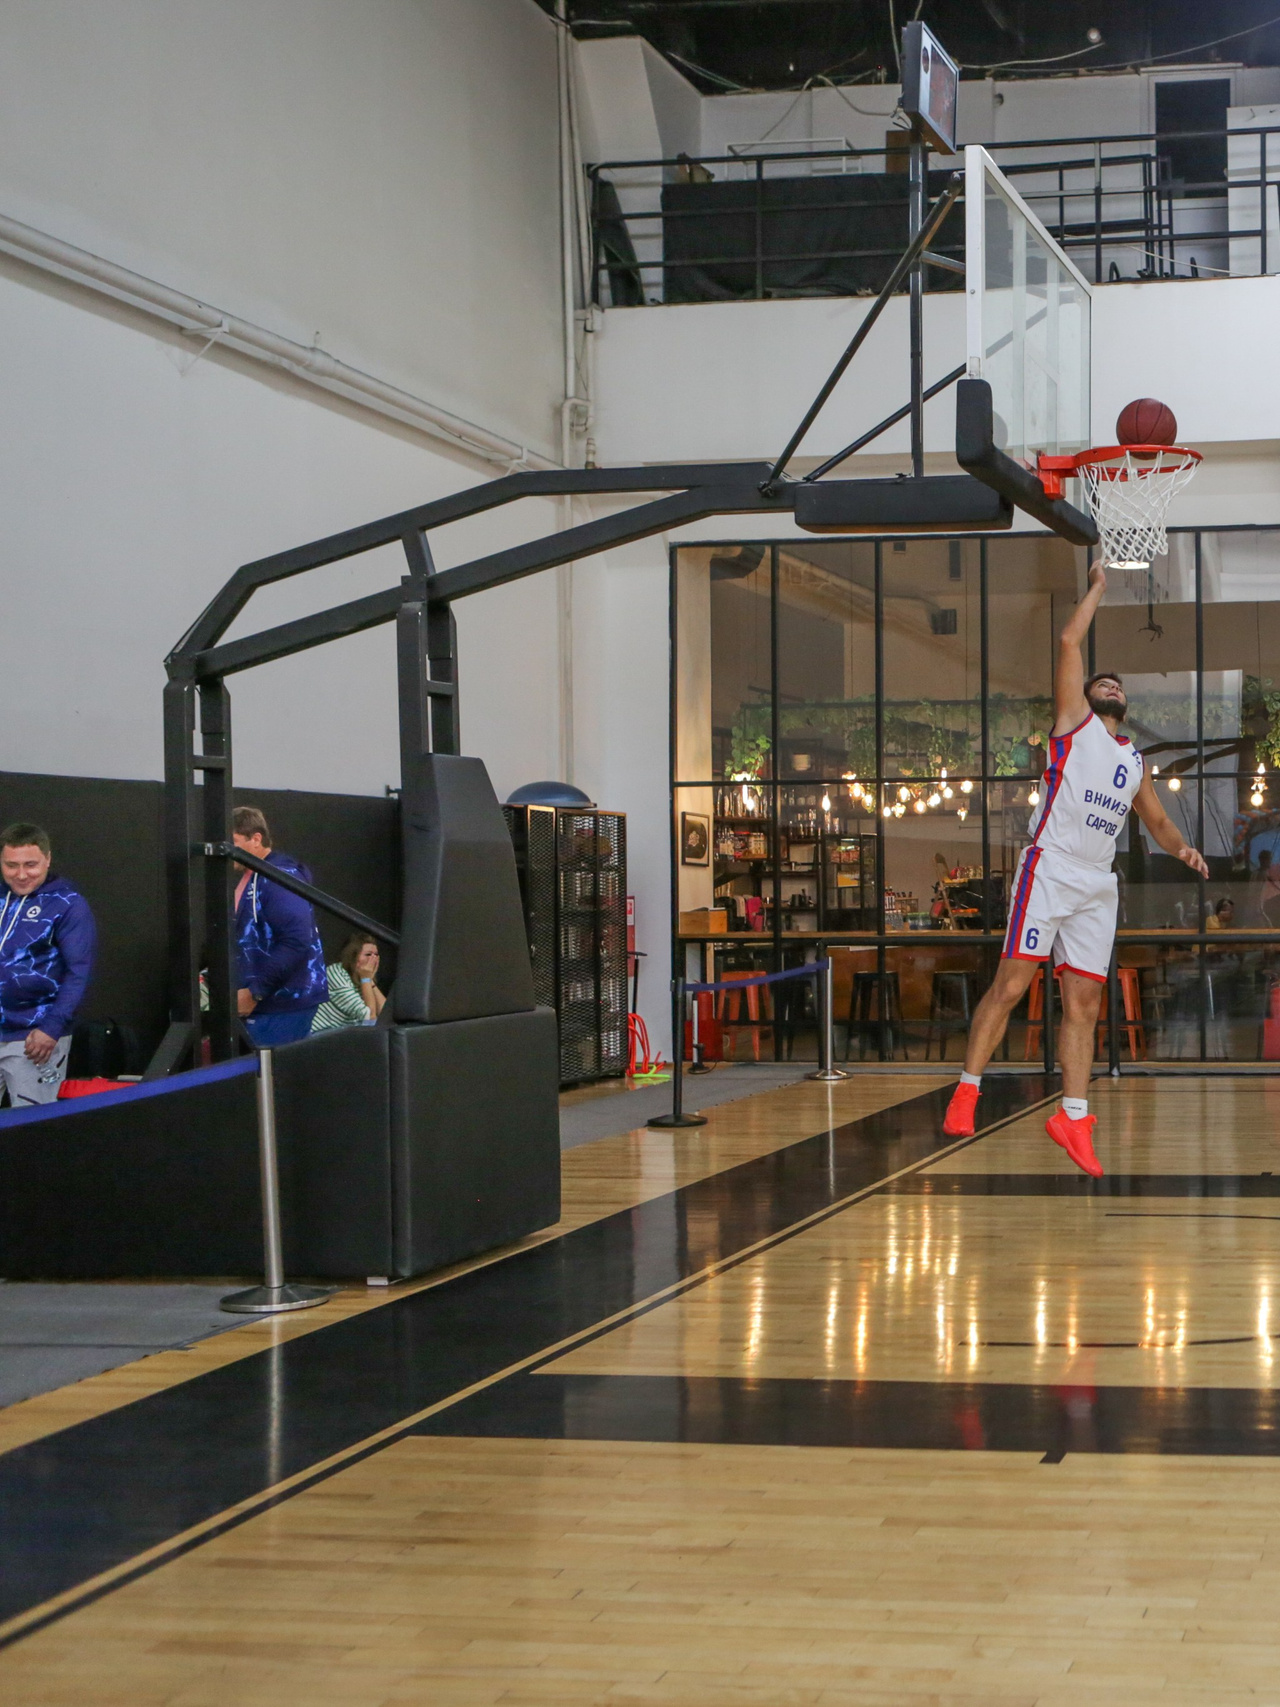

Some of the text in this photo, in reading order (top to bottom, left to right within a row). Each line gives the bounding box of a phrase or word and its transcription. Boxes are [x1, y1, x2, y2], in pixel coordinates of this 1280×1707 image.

[1112, 763, 1129, 790] 6
[1084, 789, 1128, 817] ВНИИЭ
[1086, 813, 1118, 837] САРОВ
[1025, 927, 1040, 950] 6
